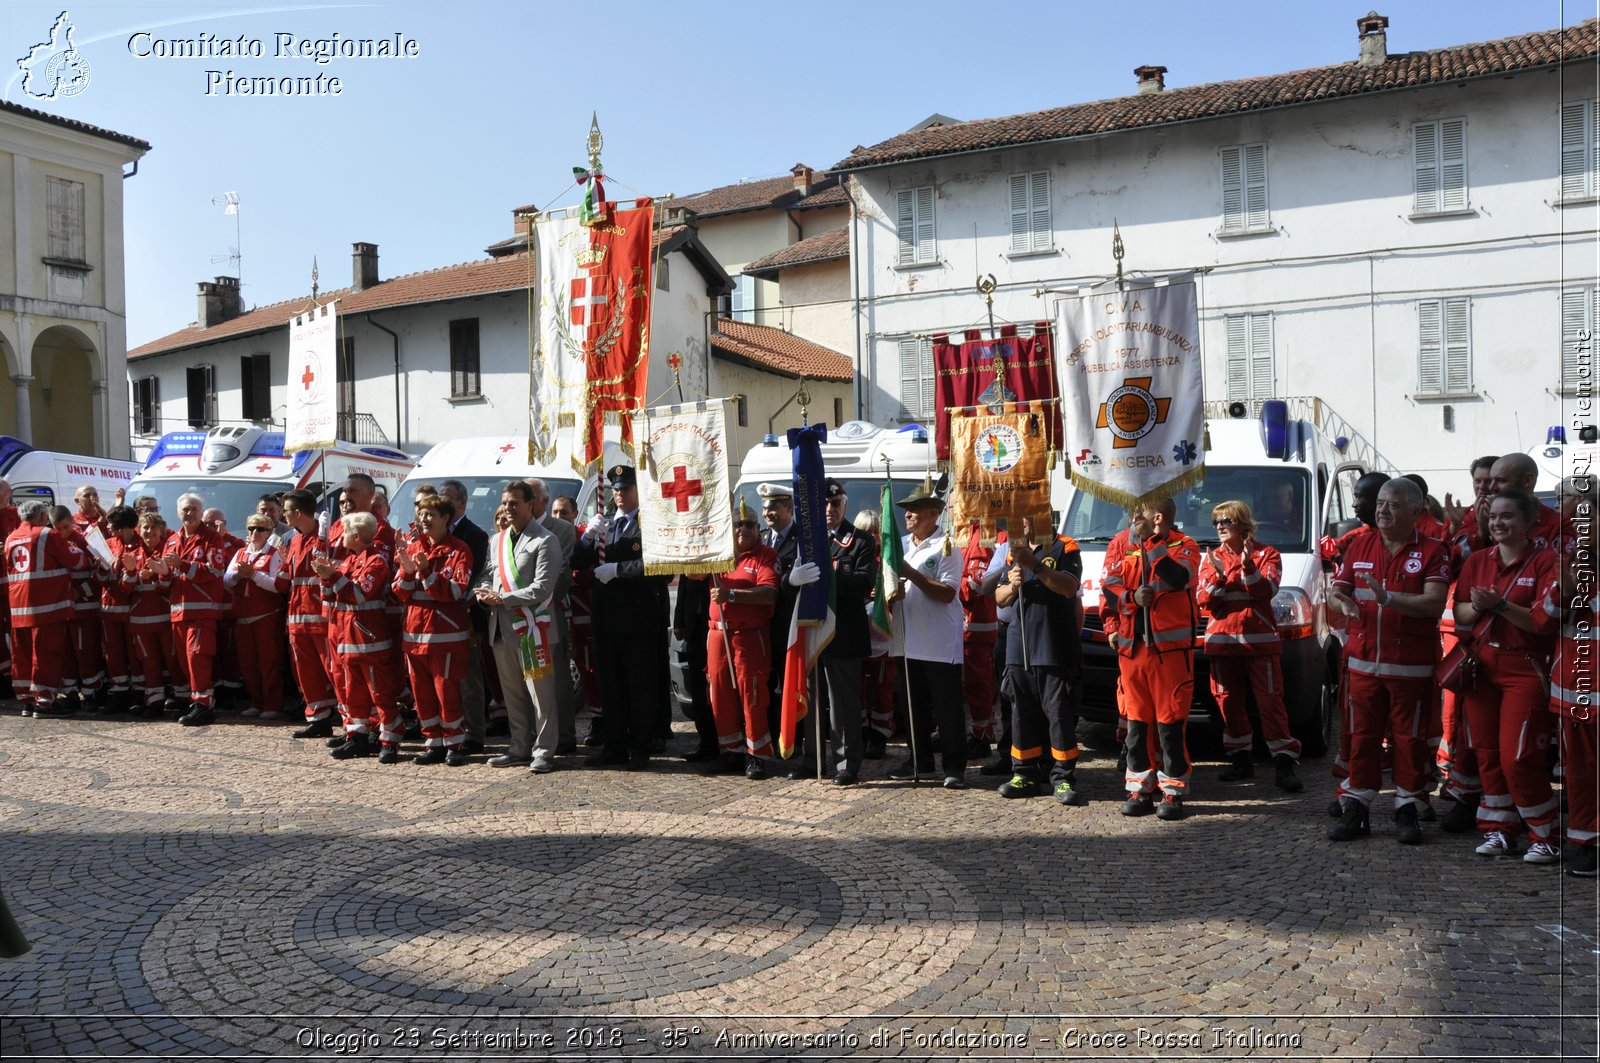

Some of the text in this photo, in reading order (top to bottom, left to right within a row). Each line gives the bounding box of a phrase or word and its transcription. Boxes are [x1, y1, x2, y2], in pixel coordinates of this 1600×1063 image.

[1066, 322, 1193, 367] CORPO VOLONTARI AMBULANZA
[1114, 347, 1140, 359] 1977
[1081, 356, 1181, 374] PUBBLICA ASSISTENZA
[691, 424, 722, 457] ITALIANA
[1118, 429, 1146, 439] ANGERA
[1110, 454, 1166, 471] ANGERA
[66, 464, 132, 480] UNITA' MOBILE
[963, 483, 982, 493] AREA
[984, 483, 992, 493] DI
[995, 482, 1014, 492] BASE
[798, 472, 813, 539] CARABINIERI
